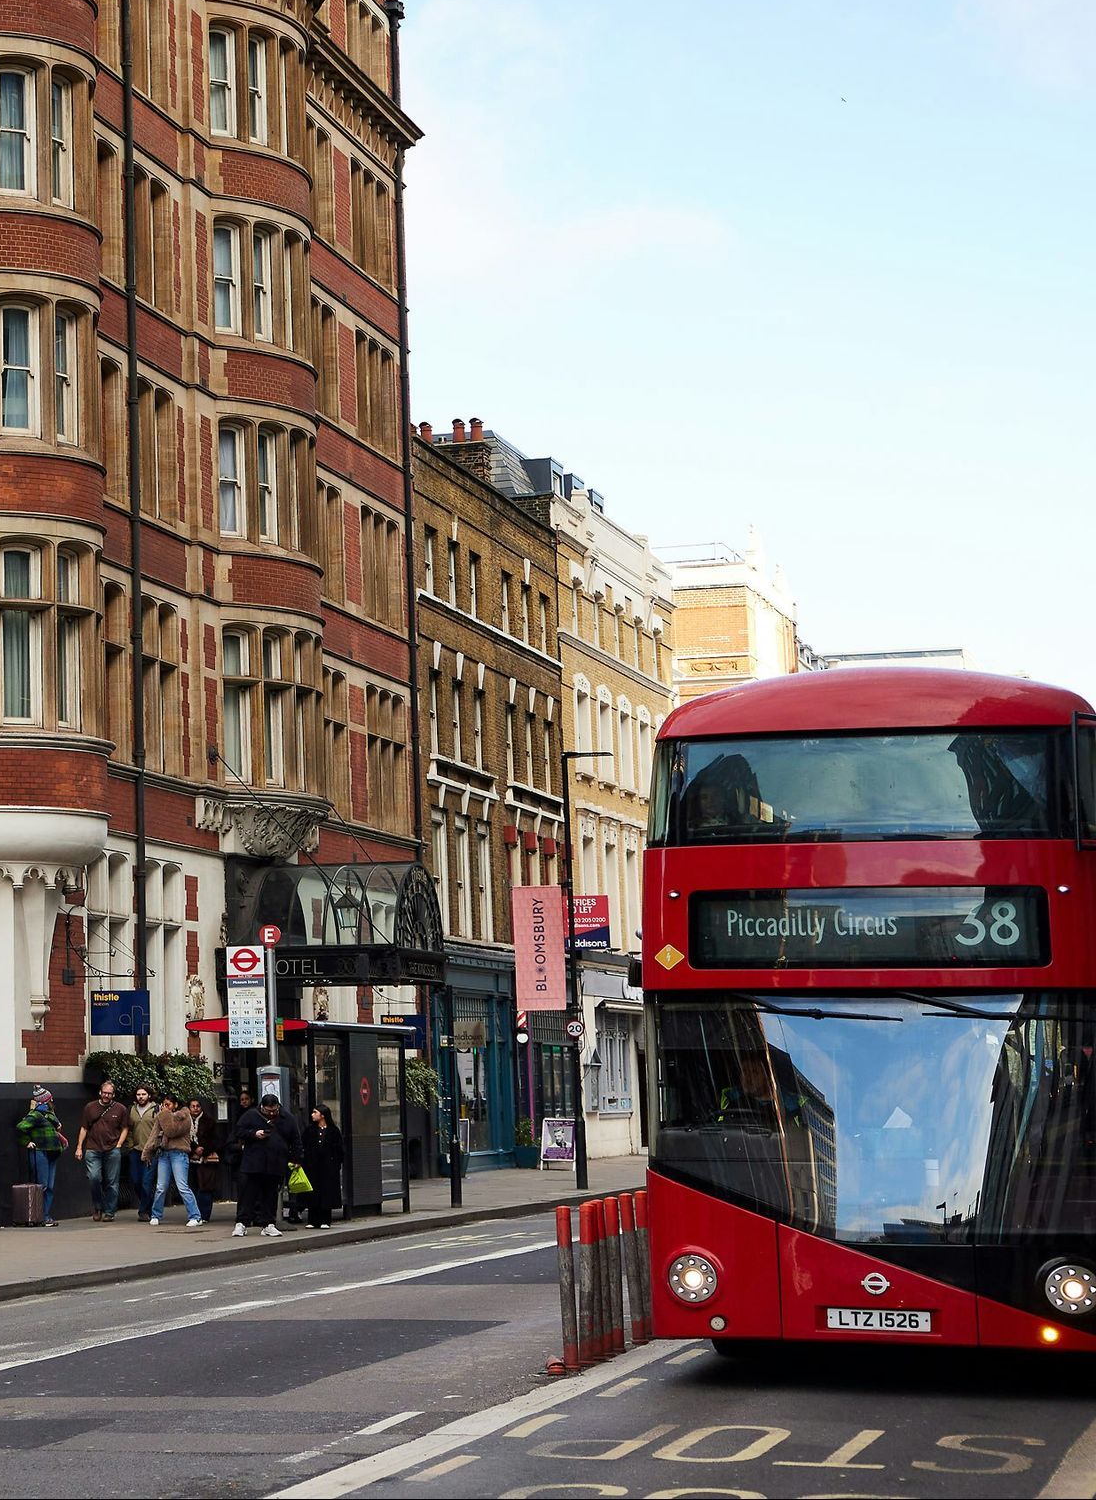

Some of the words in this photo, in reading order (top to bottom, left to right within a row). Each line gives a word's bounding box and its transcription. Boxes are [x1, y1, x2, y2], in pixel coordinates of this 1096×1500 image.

[579, 906, 592, 914] LET
[727, 909, 825, 943] Piccadilly
[834, 909, 898, 936] Circus
[955, 901, 1020, 946] 38
[264, 928, 275, 943] E
[275, 959, 324, 975] OTEL
[94, 993, 120, 1002] thistle
[568, 1025, 582, 1033] 20
[838, 1310, 874, 1327] LTZ
[879, 1312, 919, 1329] 1526
[526, 1424, 1046, 1475] STOP
